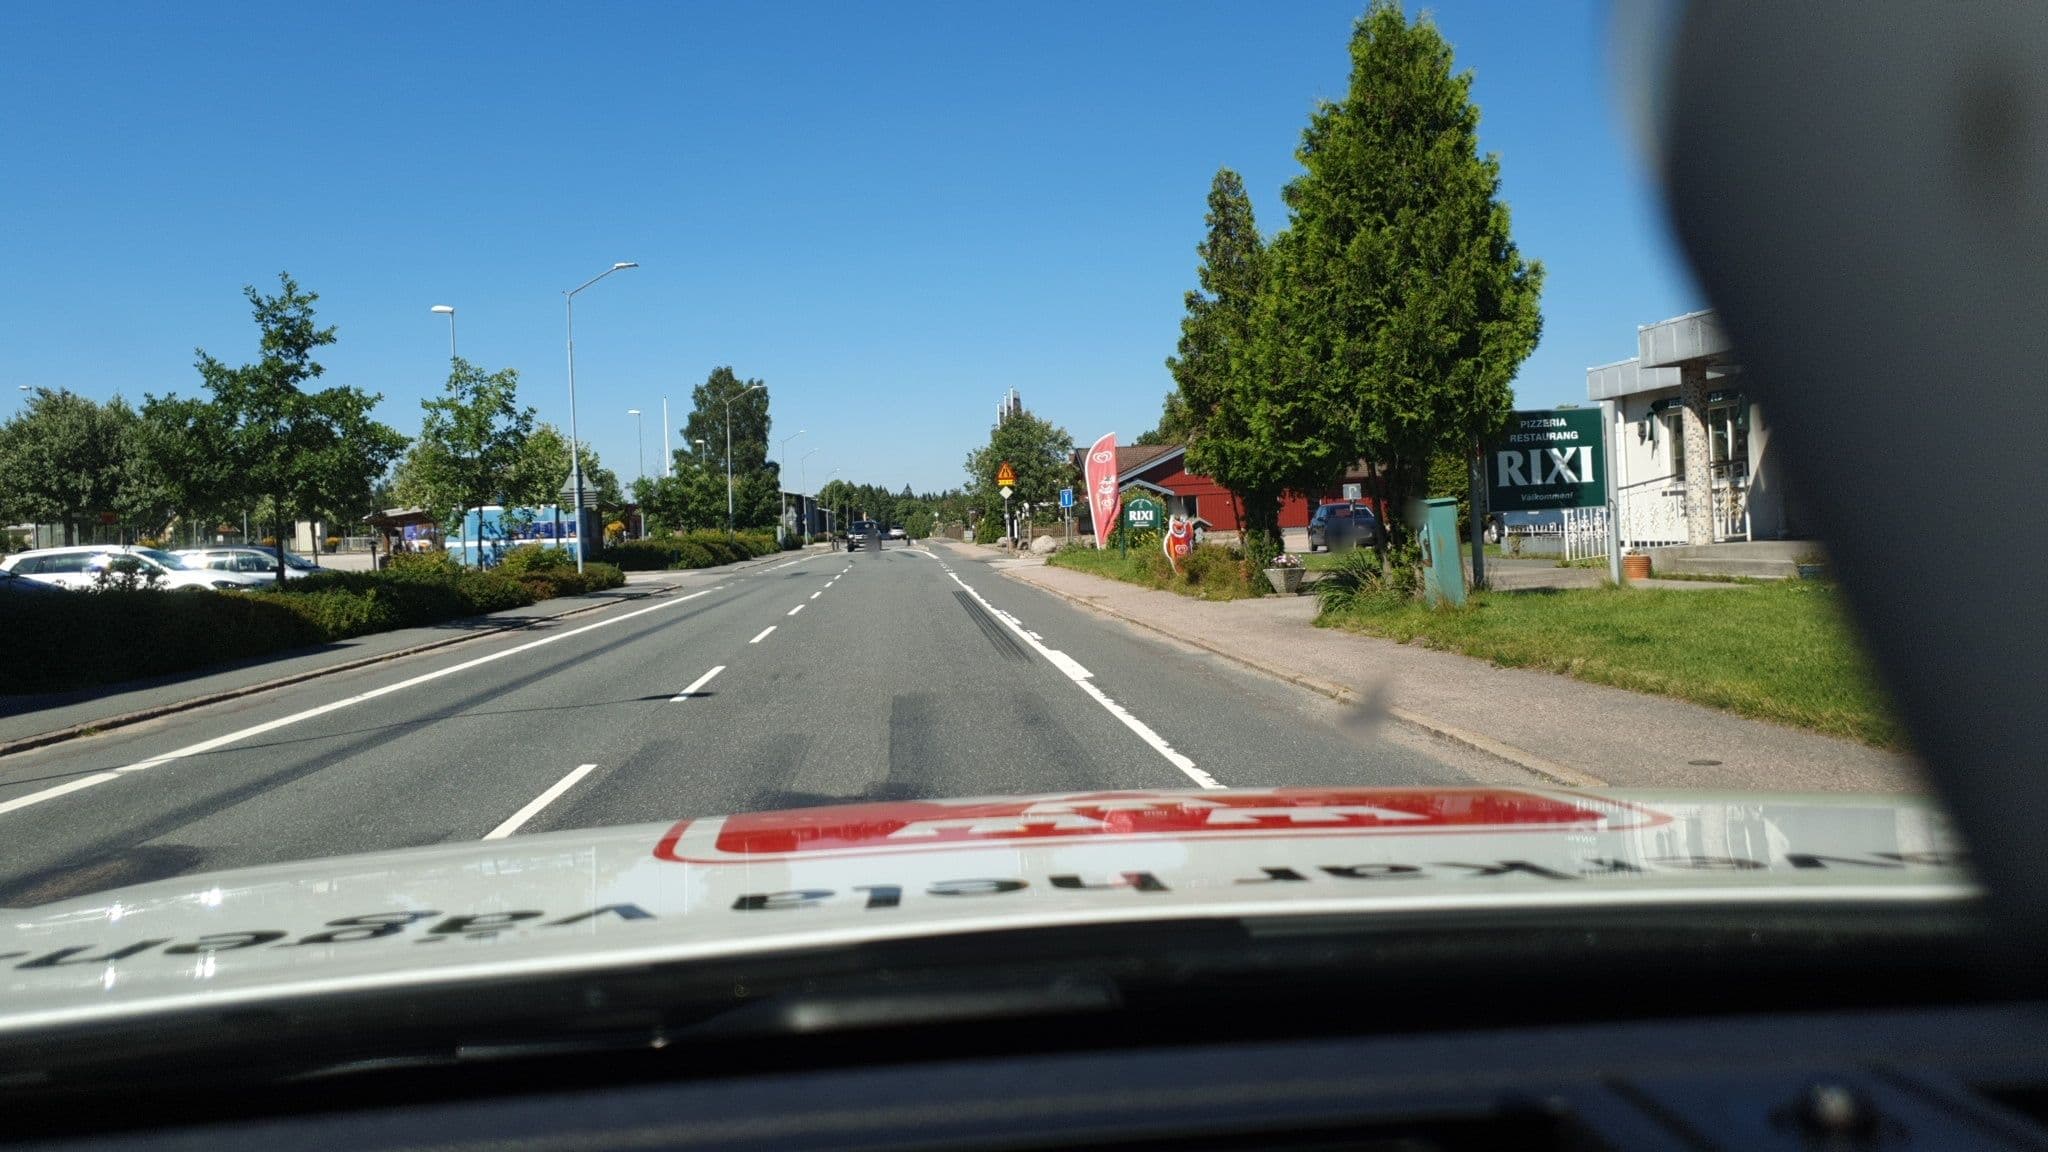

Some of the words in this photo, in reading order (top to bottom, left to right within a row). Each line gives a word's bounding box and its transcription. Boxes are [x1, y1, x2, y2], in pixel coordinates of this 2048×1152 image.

[1519, 417, 1567, 429] PIZZERIA
[1509, 430, 1579, 443] RESTAURANG
[1496, 445, 1595, 487] RIXI
[1129, 510, 1154, 521] RIXI
[732, 872, 1170, 911] hela
